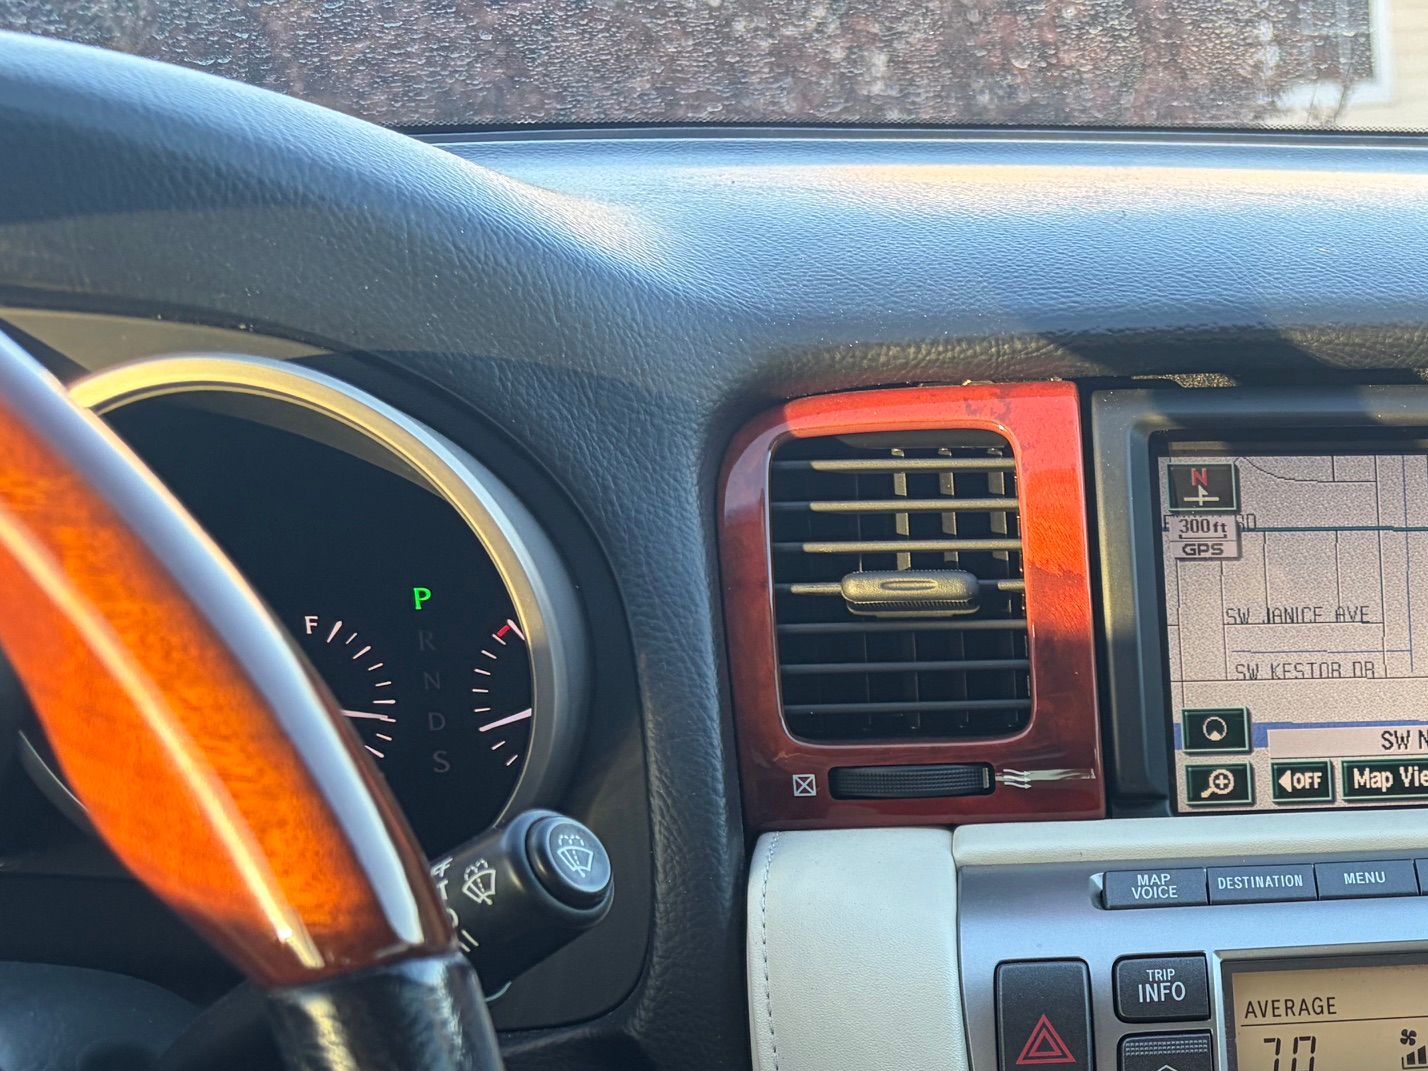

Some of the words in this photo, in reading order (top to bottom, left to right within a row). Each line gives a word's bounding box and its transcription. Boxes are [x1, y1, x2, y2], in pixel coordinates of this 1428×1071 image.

[1191, 467, 1208, 486] N
[1182, 543, 1224, 556] GPS
[413, 587, 432, 610] P
[1226, 607, 1250, 624] SW
[1263, 606, 1323, 624] JANICE
[1335, 605, 1371, 623] AVE
[304, 615, 319, 634] F
[1235, 663, 1259, 680] SW
[1271, 662, 1342, 680] KESTOR
[1352, 661, 1375, 679] DR
[1381, 730, 1411, 750] SW
[1292, 770, 1323, 790] OFF
[1353, 767, 1394, 793] Map
[1137, 873, 1171, 886] MAP
[1217, 874, 1304, 890] DESTINATION
[1343, 871, 1387, 885] MENU
[1131, 886, 1178, 900] VOICE
[1146, 968, 1176, 982] TRIP
[1138, 981, 1187, 1003] INFO
[1244, 996, 1338, 1019] AVERAGE
